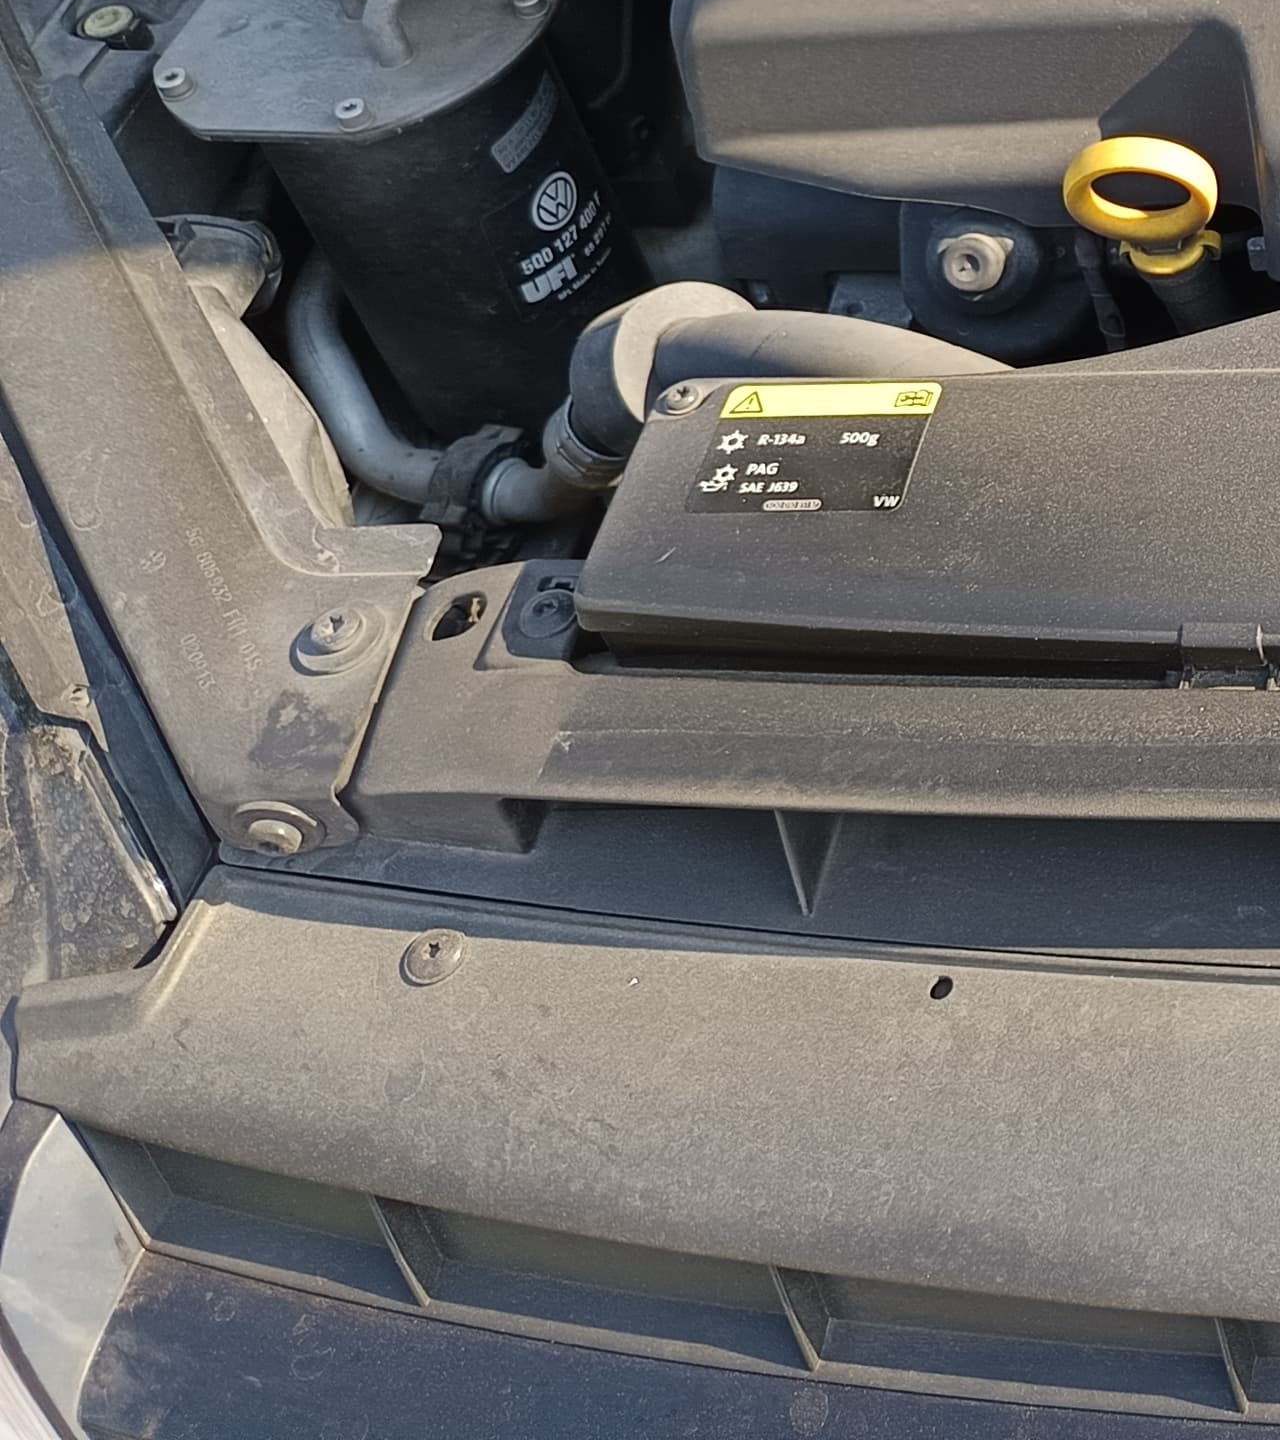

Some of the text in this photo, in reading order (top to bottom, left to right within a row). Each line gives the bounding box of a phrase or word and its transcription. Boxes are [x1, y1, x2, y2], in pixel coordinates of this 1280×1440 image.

[521, 247, 553, 276] 5Q0
[553, 226, 578, 253] 127
[579, 205, 597, 230] 400
[520, 256, 578, 304] UFI
[757, 432, 880, 447] R-134a 500g
[746, 463, 779, 476] PAG
[739, 481, 798, 493] SAE J639
[873, 496, 900, 507] VW
